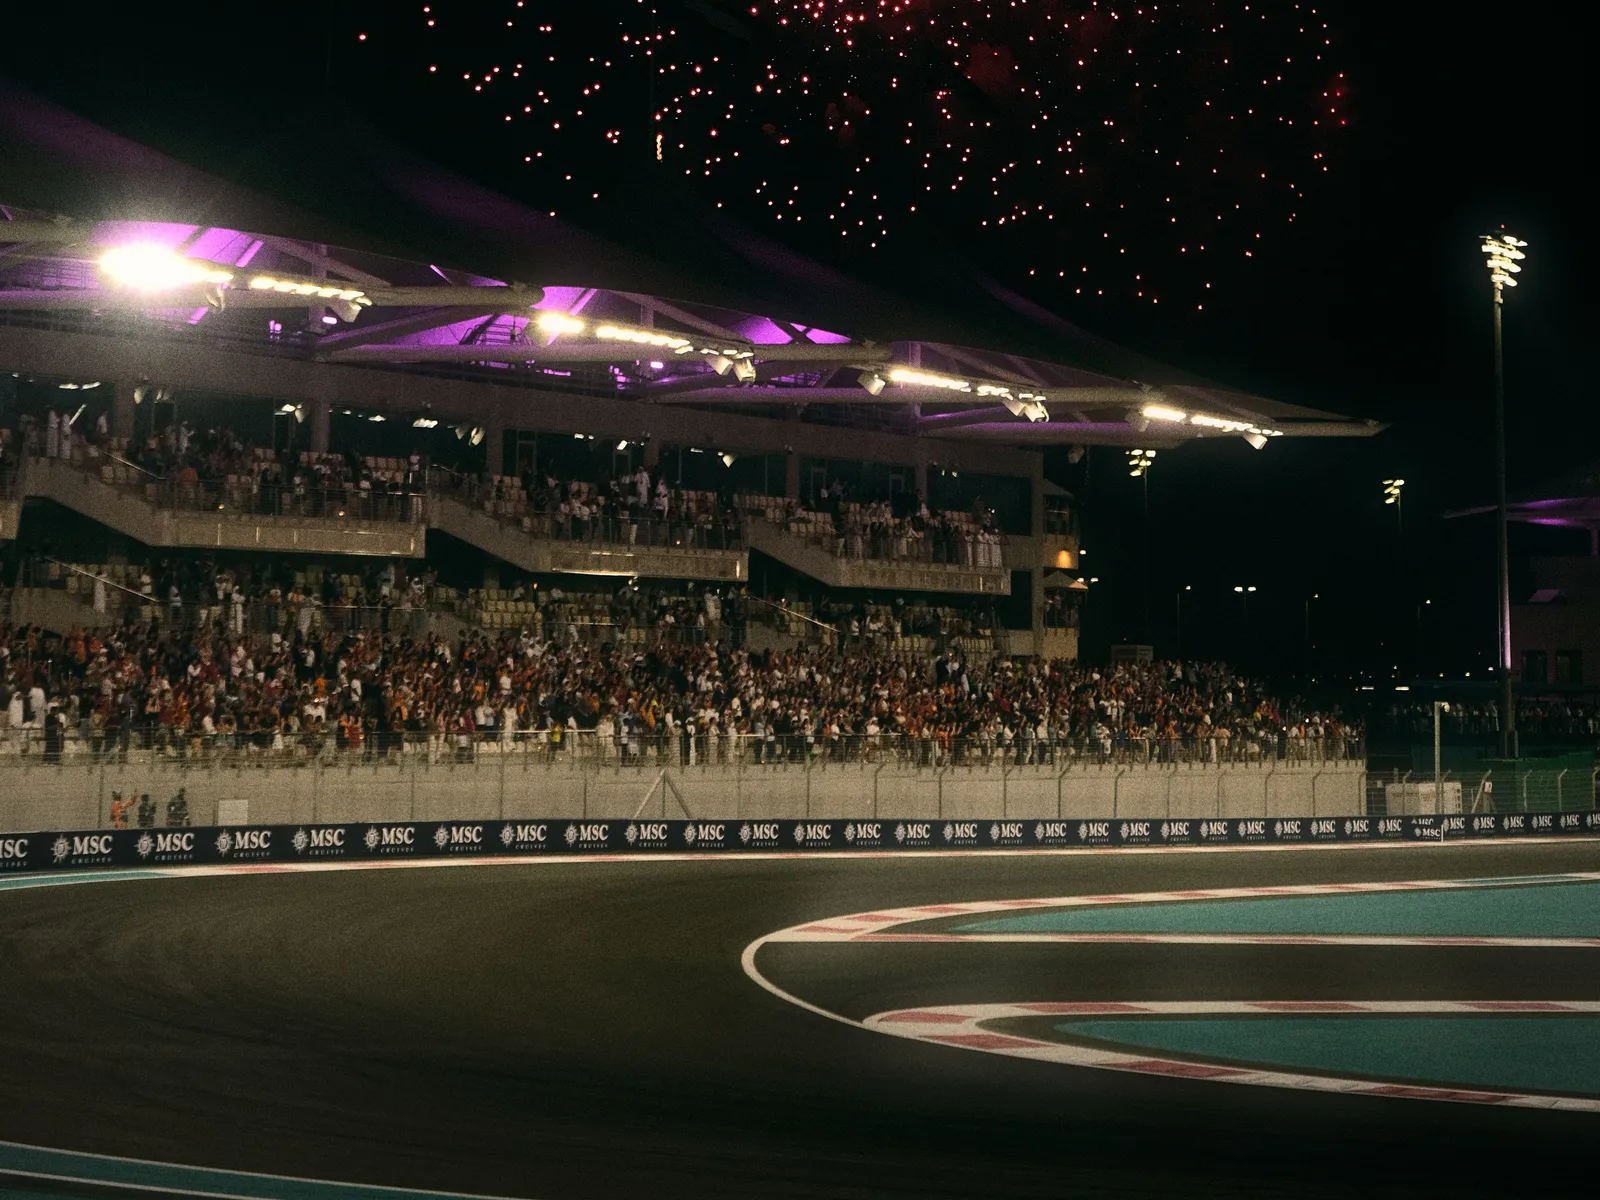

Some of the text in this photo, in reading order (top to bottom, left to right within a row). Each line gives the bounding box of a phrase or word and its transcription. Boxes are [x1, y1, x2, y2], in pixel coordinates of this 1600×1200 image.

[1247, 821, 1265, 834] MSC
[1283, 820, 1301, 834] MSC
[1319, 820, 1336, 833] MSC
[1352, 819, 1369, 832] MSC
[1386, 819, 1402, 832] MSC
[1450, 817, 1466, 829] MSC
[1480, 817, 1496, 829] MSC
[1510, 816, 1525, 828] MSC
[1539, 815, 1553, 827] MSC
[1566, 815, 1580, 826] MSC
[450, 826, 483, 843] MSC
[516, 824, 548, 842] MSC
[579, 824, 609, 841] MSC
[640, 823, 668, 840] MSC
[698, 824, 725, 840] MSC
[753, 823, 779, 839] MSC
[806, 824, 831, 840] MSC
[857, 823, 881, 839] MSC
[907, 823, 931, 839] MSC
[955, 823, 978, 838] MSC
[1001, 823, 1023, 838] MSC
[1045, 823, 1067, 837] MSC
[1089, 822, 1109, 837] MSC
[1130, 822, 1150, 836] MSC
[1170, 822, 1190, 836] MSC
[1209, 821, 1228, 835] MSC
[1422, 828, 1441, 837] MSC
[156, 833, 195, 851] MSC
[235, 830, 272, 849] MSC
[310, 828, 345, 846] MSC
[381, 827, 415, 845] MSC
[73, 836, 113, 855] MSC
[72, 857, 112, 865] CRUISES
[155, 853, 193, 861] CRUISES
